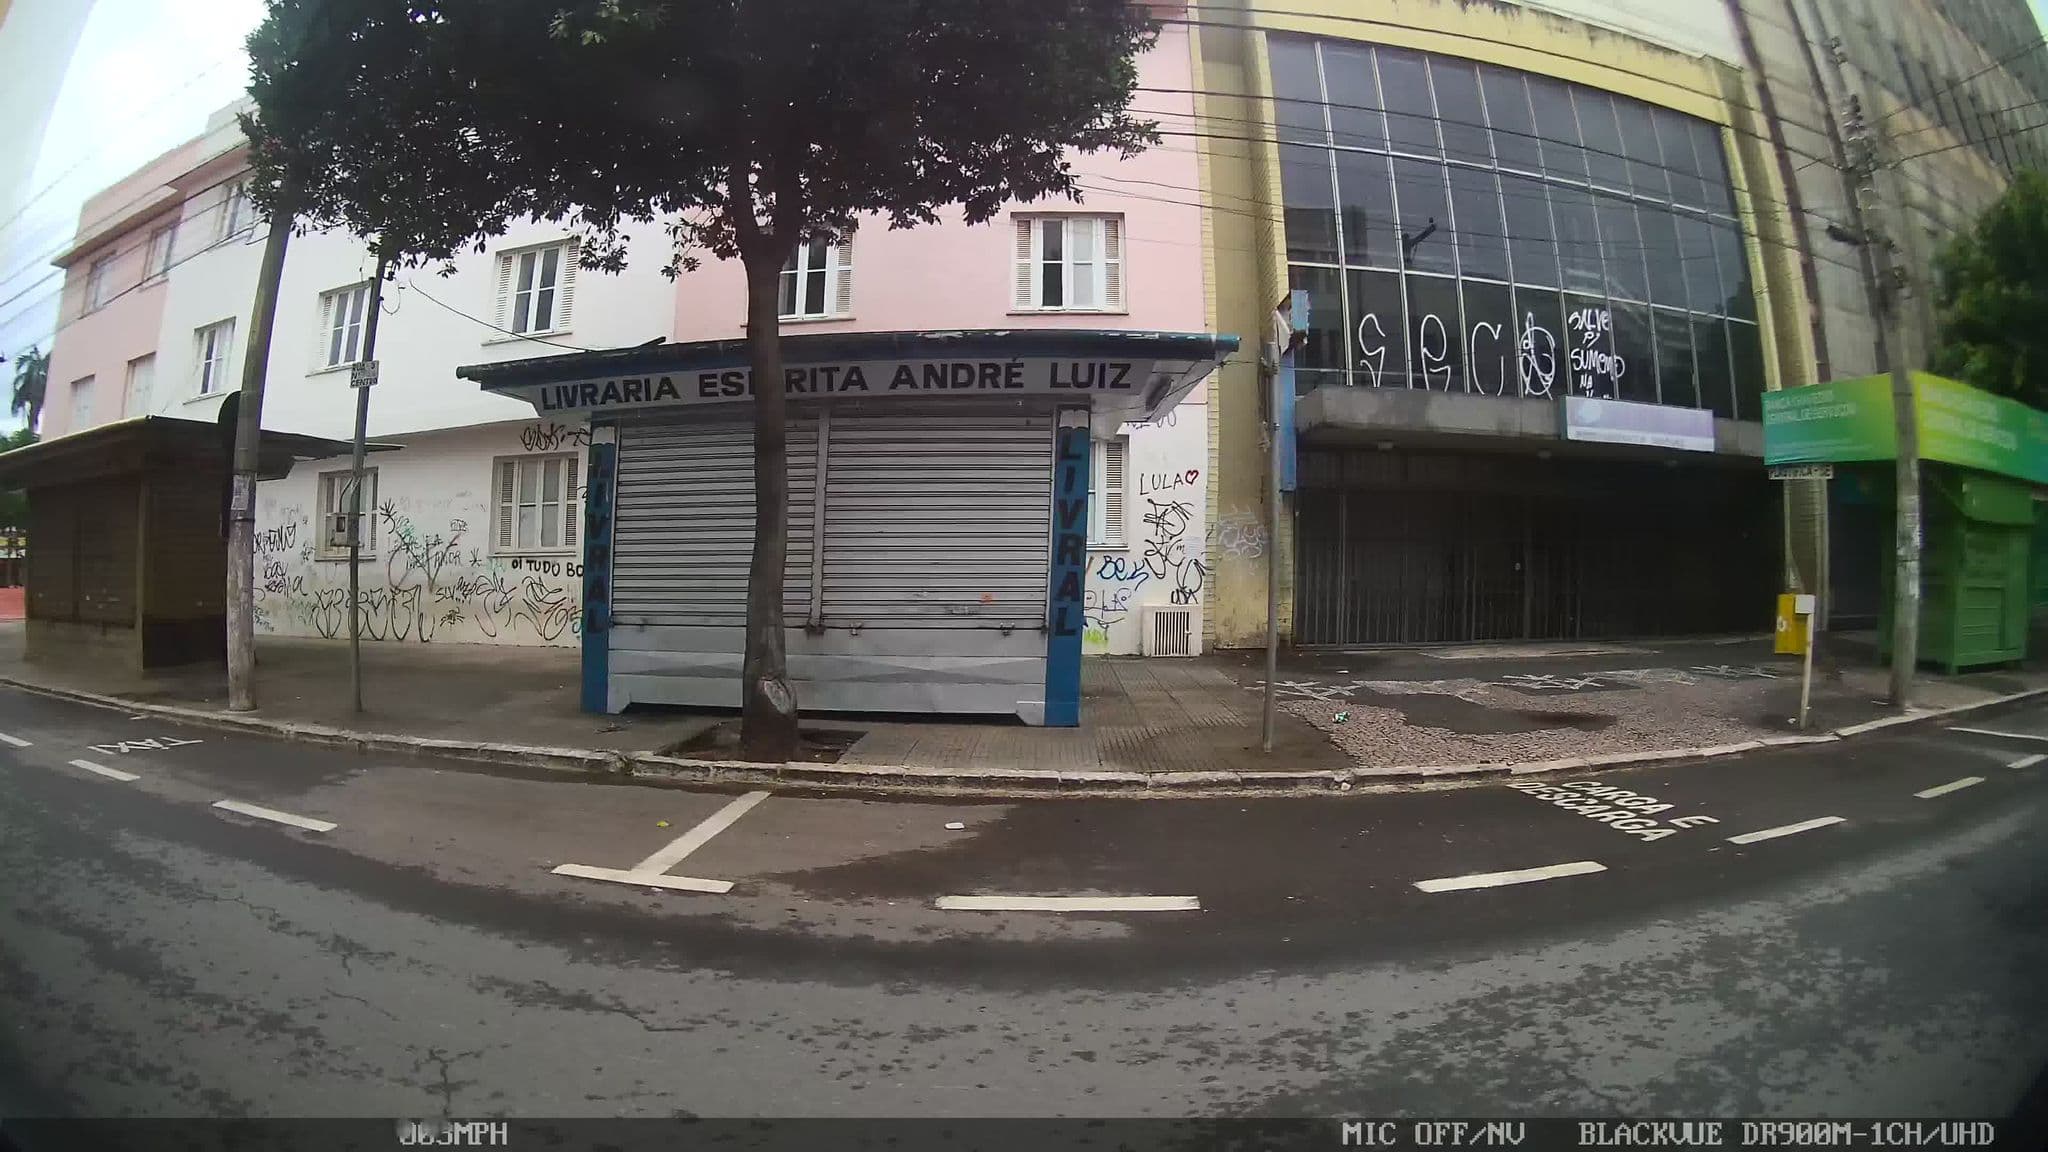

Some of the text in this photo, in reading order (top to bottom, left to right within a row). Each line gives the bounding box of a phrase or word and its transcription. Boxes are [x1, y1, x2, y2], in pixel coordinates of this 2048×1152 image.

[541, 355, 1132, 411] LIVRARIA ESRITA ANDRÉ LUIZ
[1140, 473, 1184, 495] LULA
[1055, 432, 1084, 636] LIVRAL
[526, 560, 561, 577] TUDO
[1506, 782, 1678, 842] DESCARGA
[1562, 781, 1721, 829] CARGA E
